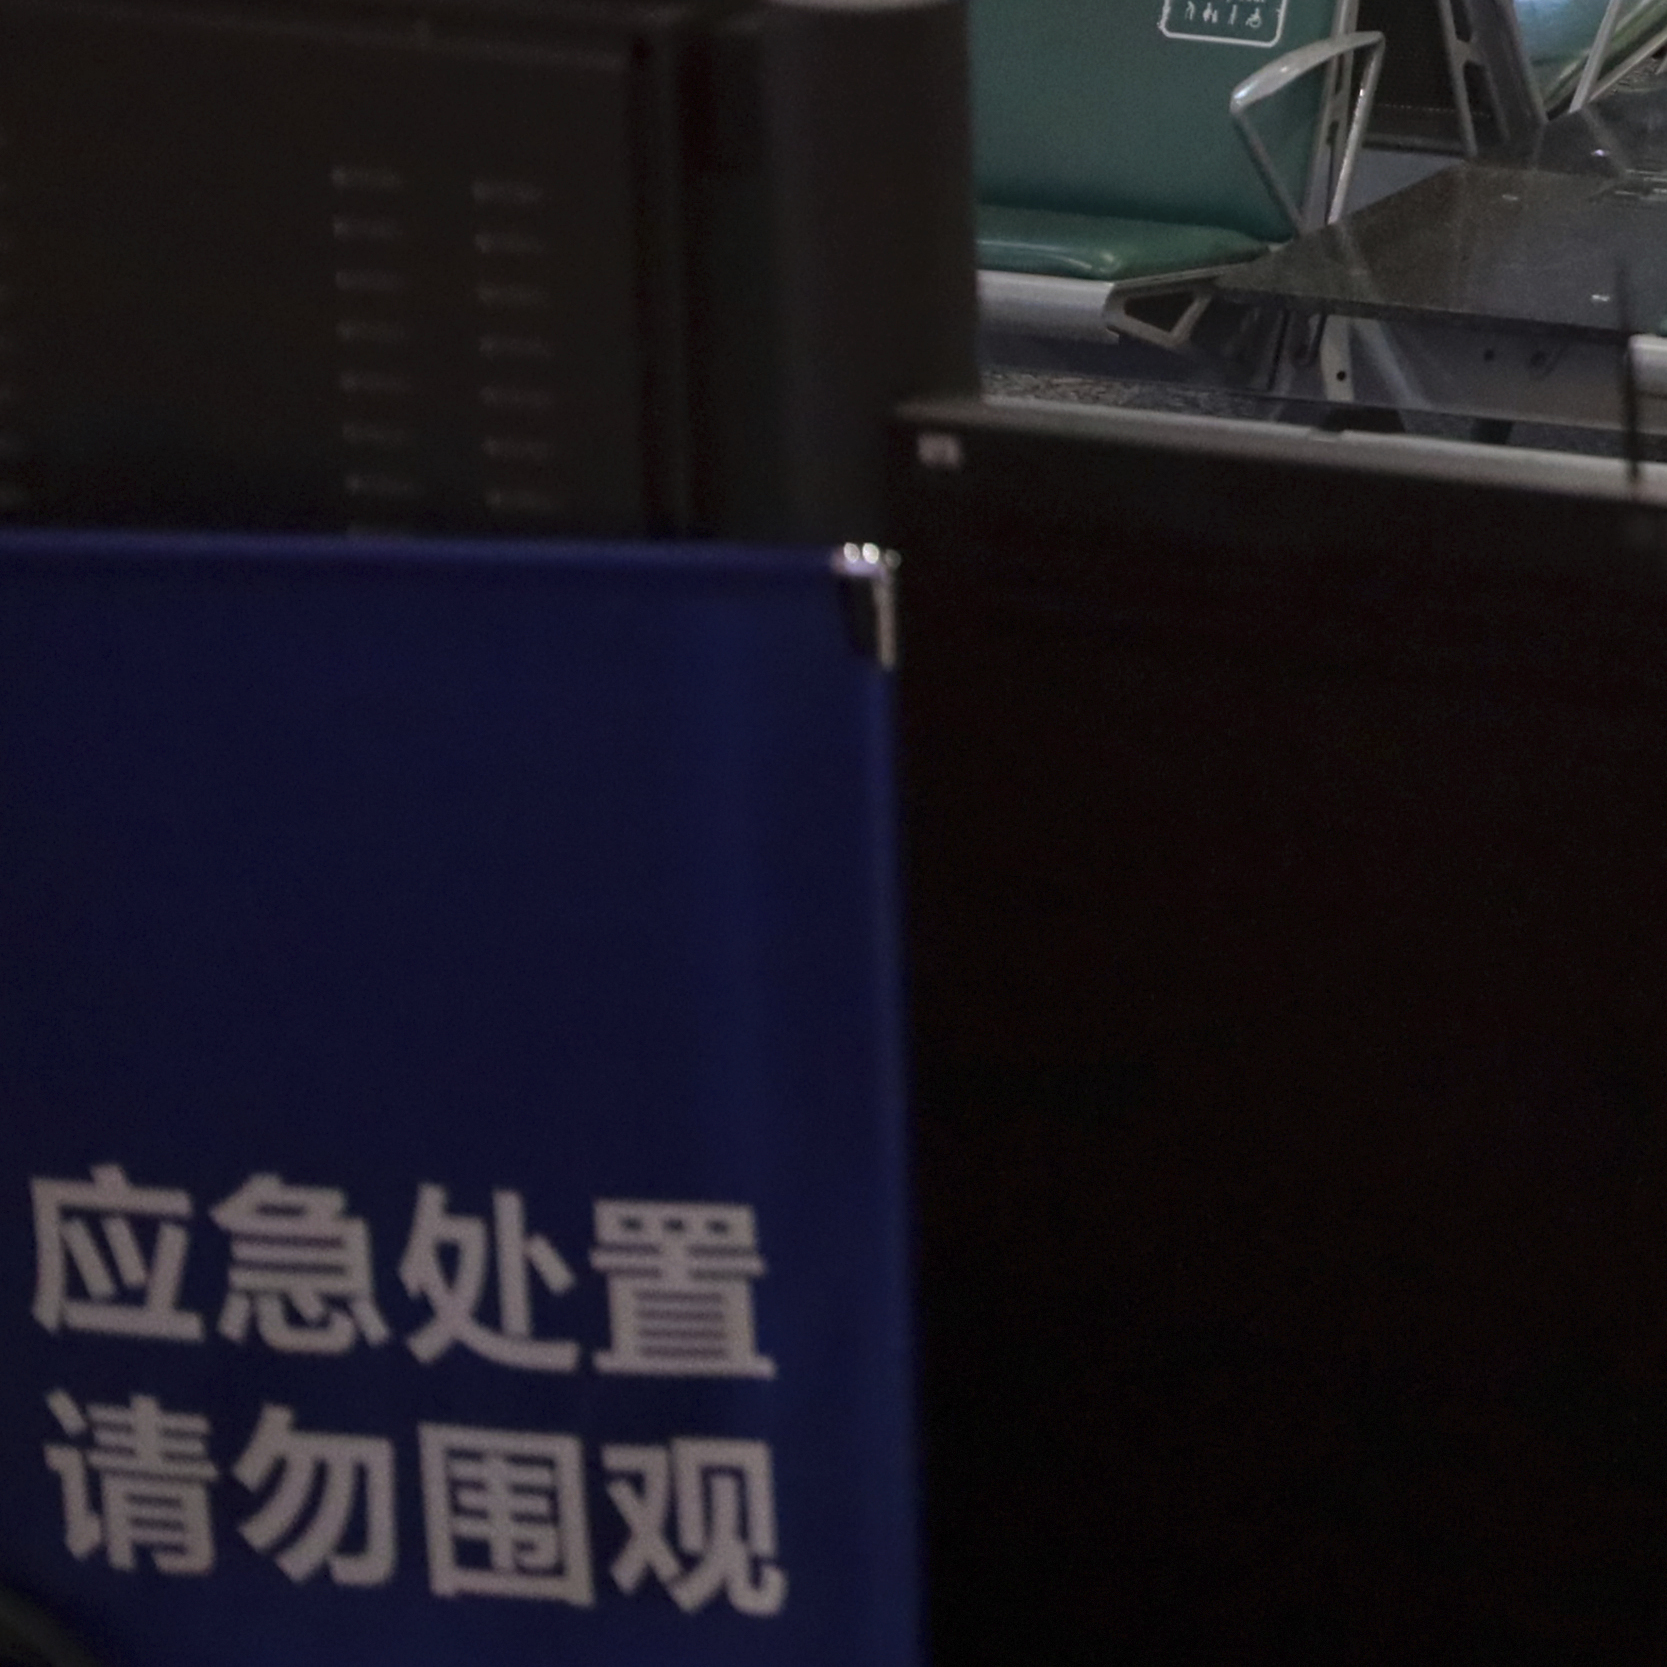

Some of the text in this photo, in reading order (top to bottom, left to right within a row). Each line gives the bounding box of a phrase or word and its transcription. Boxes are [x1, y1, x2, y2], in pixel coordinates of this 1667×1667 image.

[28, 1162, 778, 1380] 应急处置
[43, 1387, 789, 1617] 请勿围观
